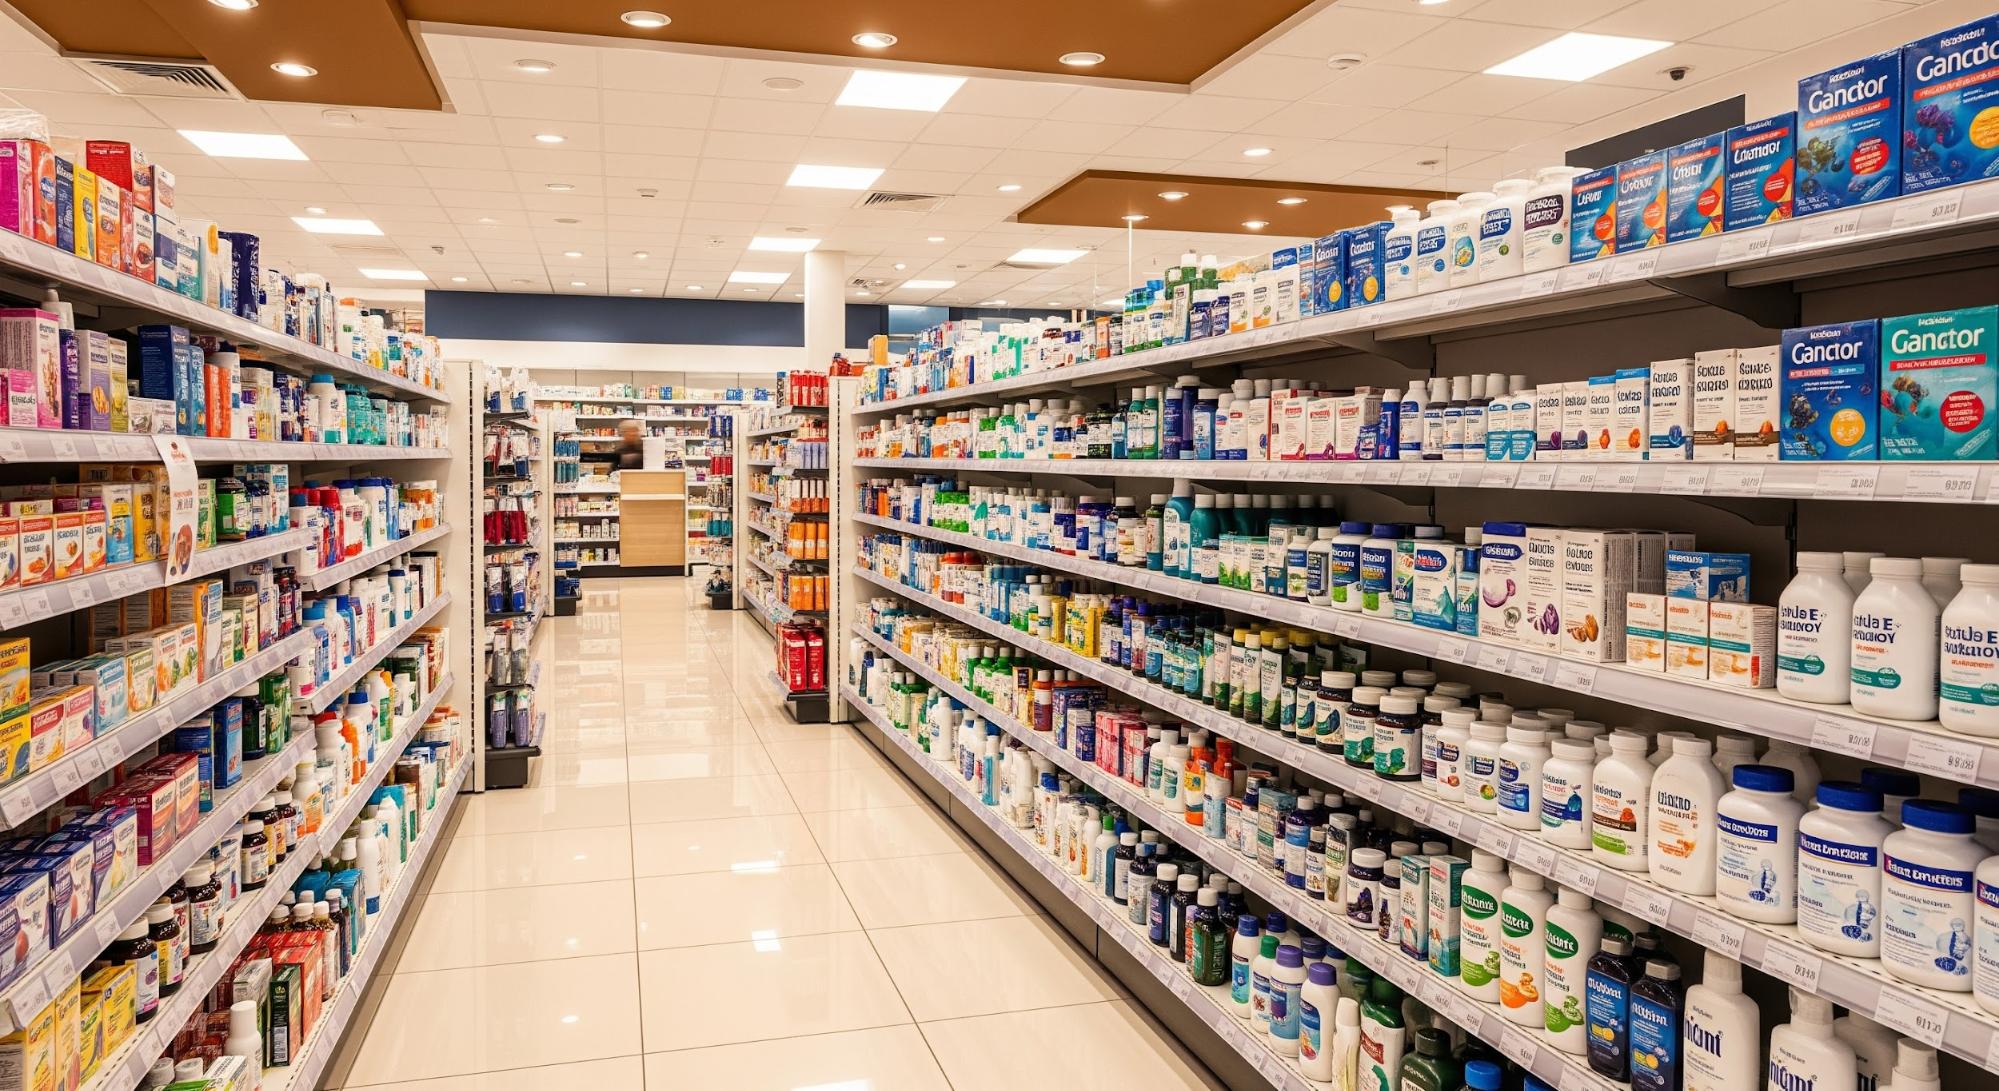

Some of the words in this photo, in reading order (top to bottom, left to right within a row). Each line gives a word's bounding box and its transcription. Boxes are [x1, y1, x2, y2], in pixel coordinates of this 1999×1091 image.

[1808, 74, 1888, 114] Ganctor
[1791, 341, 1863, 365] Ganctor
[1891, 327, 1985, 355] Ganctor
